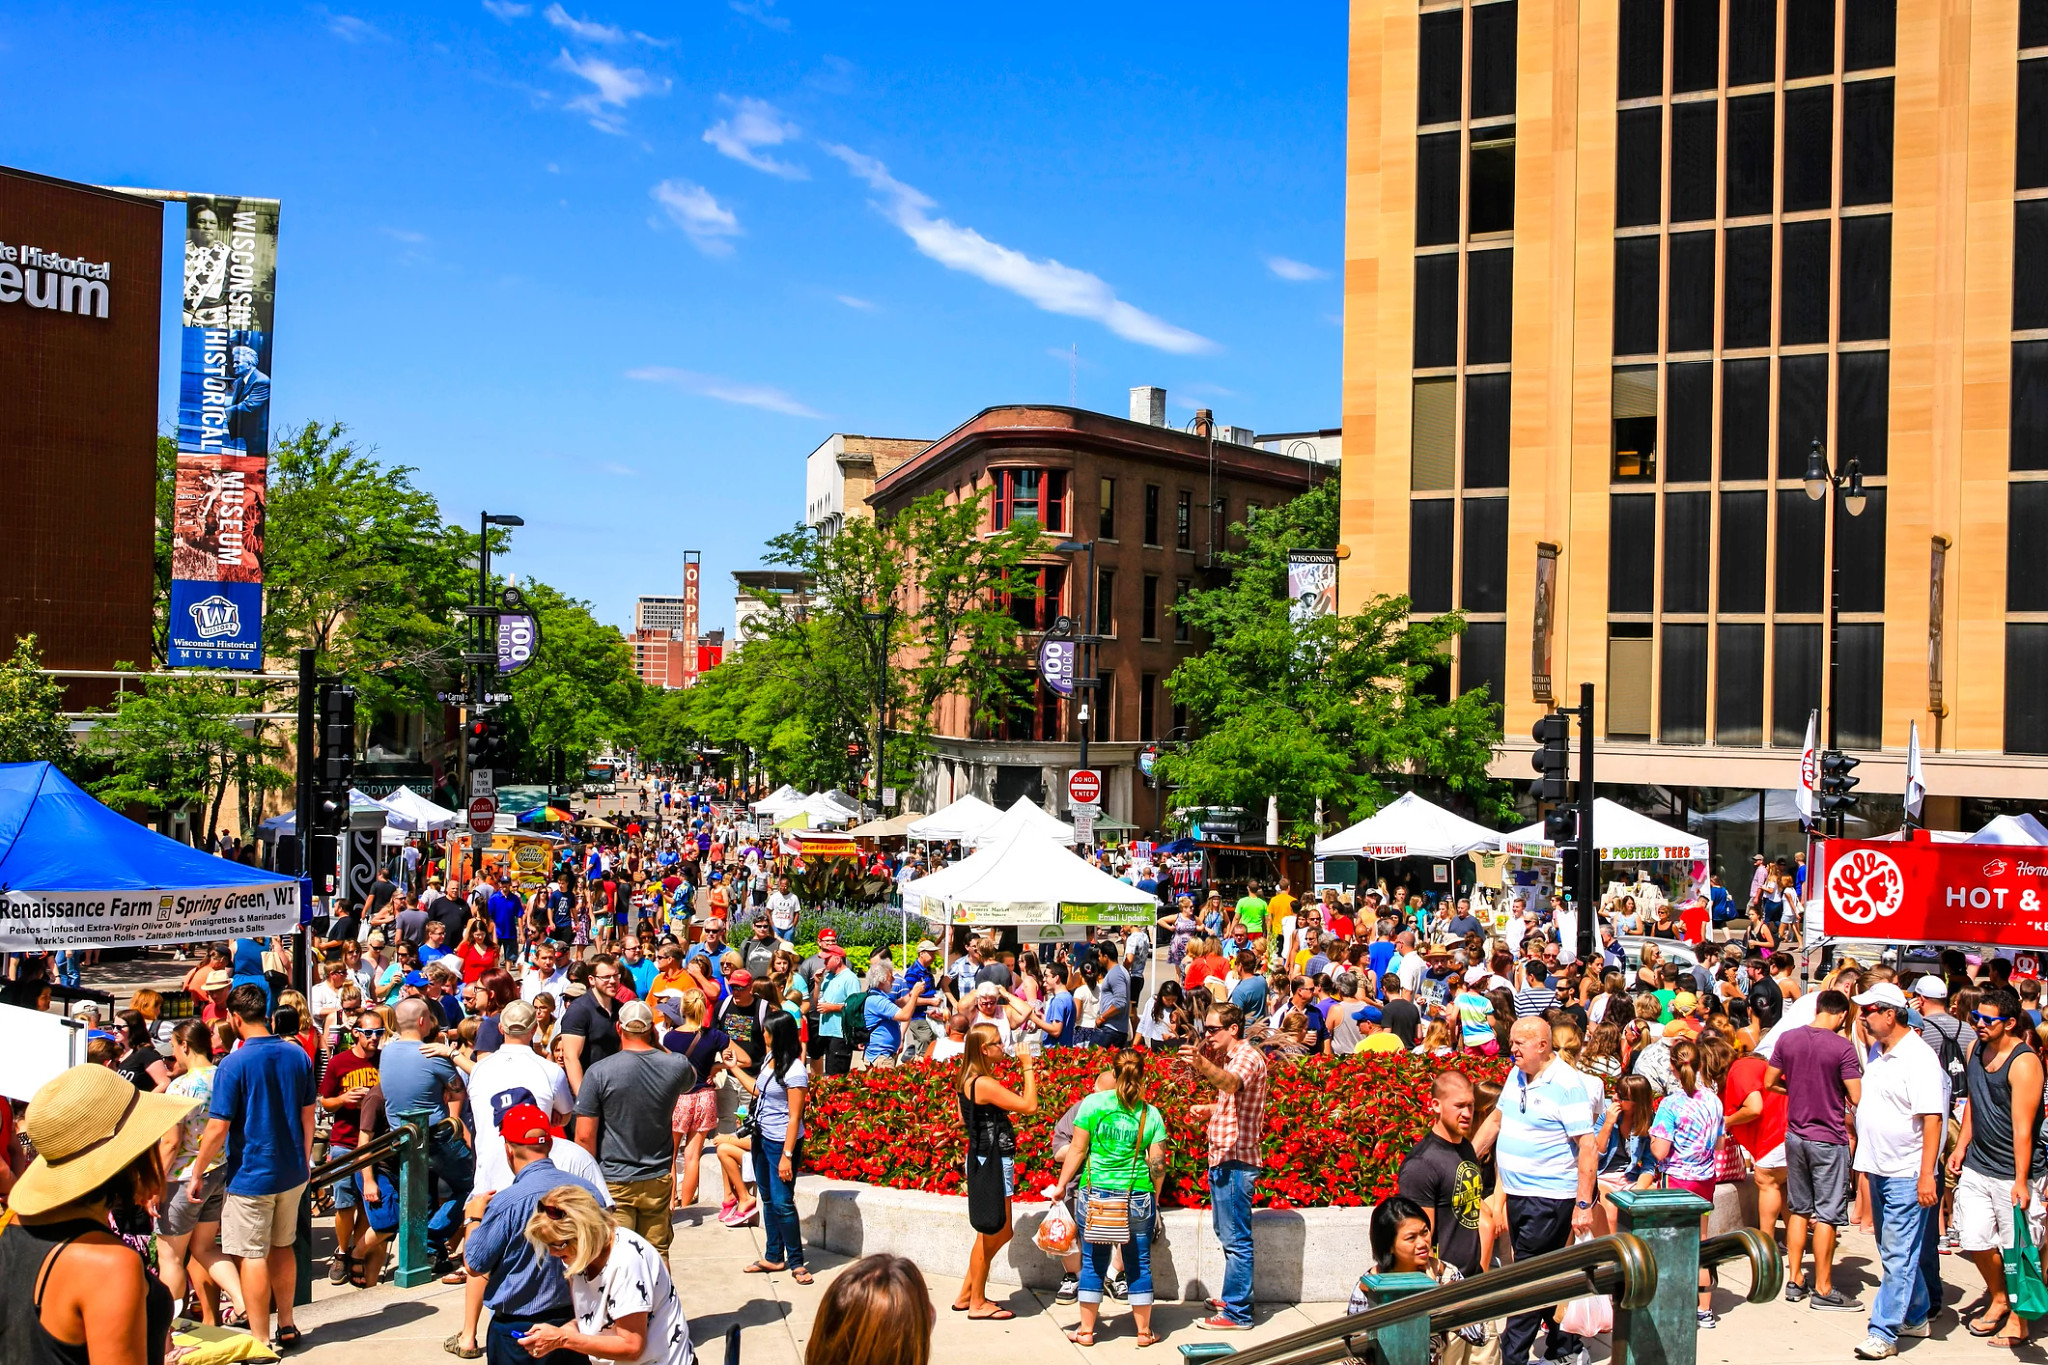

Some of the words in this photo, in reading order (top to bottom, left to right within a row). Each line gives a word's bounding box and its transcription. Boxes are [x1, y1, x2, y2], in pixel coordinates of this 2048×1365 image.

[21, 245, 110, 281] Historical
[228, 211, 257, 326] WISCONSIN
[201, 331, 228, 450] HISTORICAL
[218, 471, 245, 566] MUSEUM
[1290, 554, 1335, 563] WISCONSIN
[204, 623, 234, 634] HISTORY
[511, 617, 530, 661] 100
[174, 638, 215, 648] Wisconsin
[217, 640, 257, 650] Historical
[499, 624, 510, 662] BLOCK
[180, 650, 249, 660] MUSEUM
[1045, 643, 1063, 682] 100
[1062, 650, 1074, 686] BLOCK
[478, 771, 488, 779] NO
[1370, 845, 1381, 855] UW
[1384, 845, 1406, 854] SCENES
[1612, 847, 1659, 859] POSTERS
[1664, 847, 1690, 858] TEES
[0, 898, 105, 919] Renaissance
[110, 898, 153, 917] Farm
[175, 895, 222, 918] Spring
[224, 892, 270, 911] Green,
[273, 887, 294, 906] WI
[1062, 904, 1074, 913] ign
[1117, 904, 1143, 913] Weekly
[1946, 886, 2009, 909] HOT
[2019, 889, 2041, 911] &
[9, 926, 41, 934] Pestos
[51, 925, 84, 933] Infused
[87, 922, 139, 932] Extra-Virgin
[141, 922, 163, 931] Olive
[165, 921, 181, 929] Oils
[189, 915, 237, 927] Vinaigrettes
[247, 912, 286, 922] Marinades
[1070, 913, 1089, 921] Here
[1098, 913, 1119, 922] Email
[1121, 913, 1150, 923] Updates
[35, 936, 65, 945] Mark's
[67, 935, 112, 943] Cinnamon
[114, 931, 136, 941] Rolls
[175, 927, 227, 938] Herb-Infused
[229, 926, 244, 934] Sea
[246, 924, 265, 932] Salts
[342, 1067, 380, 1087] MINNES
